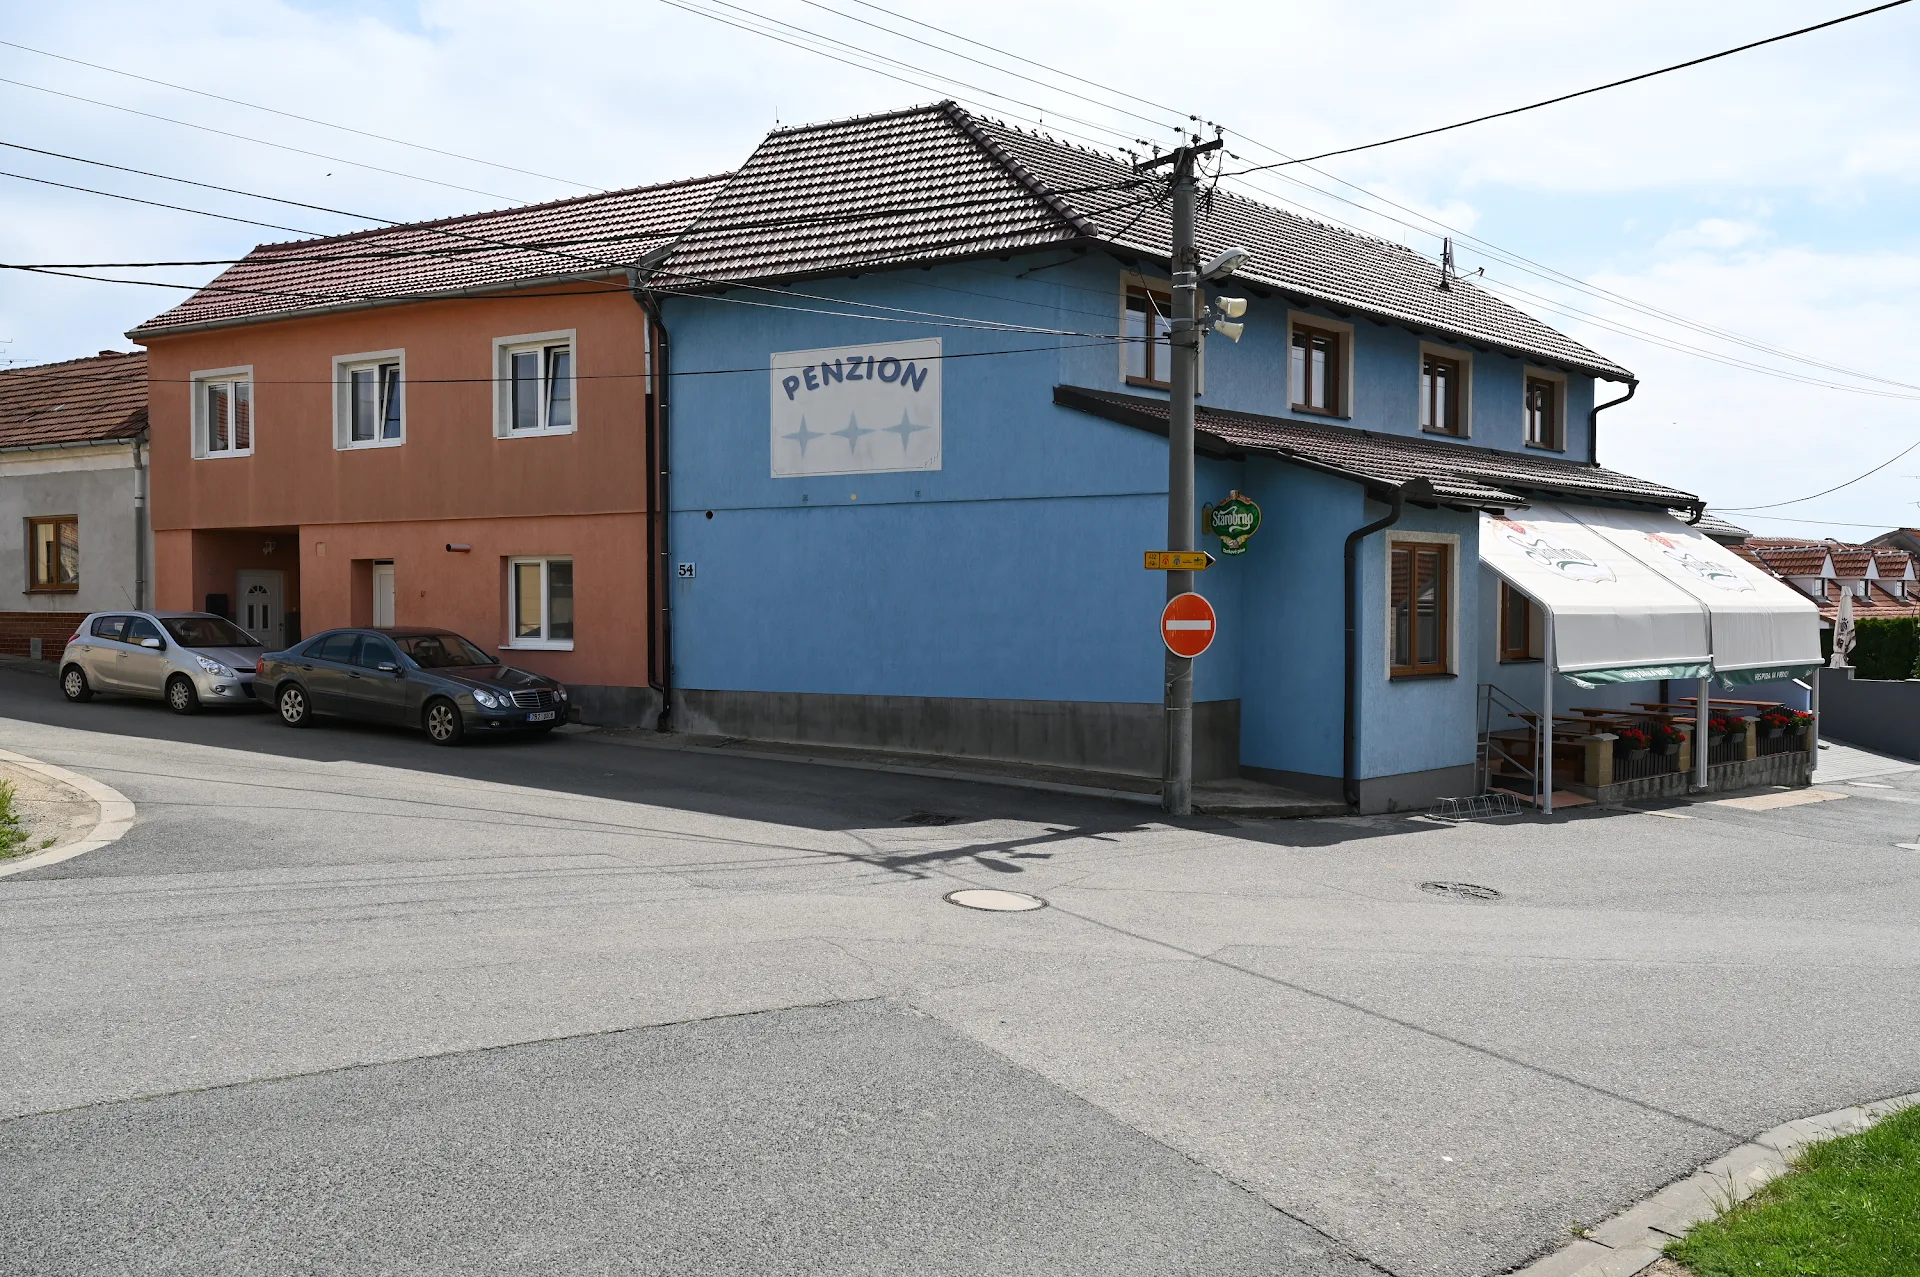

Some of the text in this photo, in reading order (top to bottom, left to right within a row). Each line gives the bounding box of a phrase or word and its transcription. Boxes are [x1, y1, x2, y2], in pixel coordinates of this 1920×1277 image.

[781, 355, 929, 401] PENZION
[1212, 505, 1254, 534] Starobrno
[678, 564, 694, 576] 54
